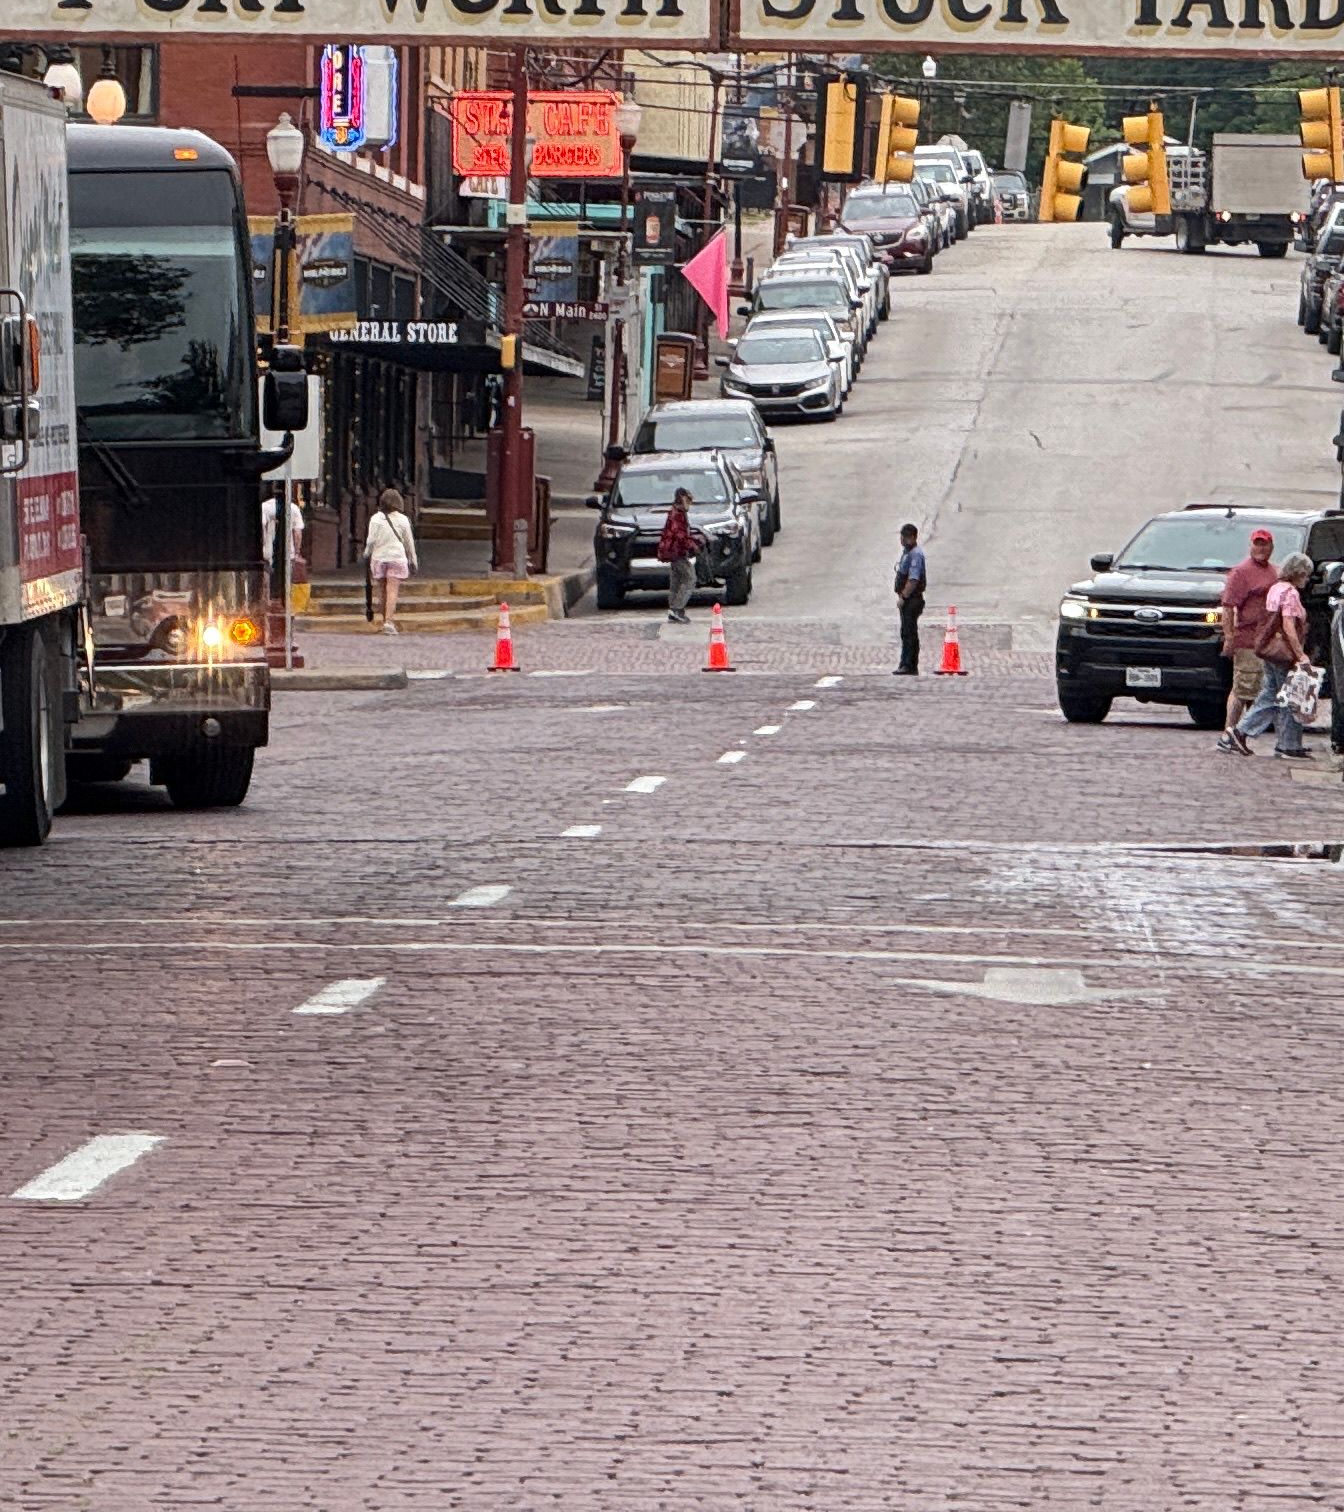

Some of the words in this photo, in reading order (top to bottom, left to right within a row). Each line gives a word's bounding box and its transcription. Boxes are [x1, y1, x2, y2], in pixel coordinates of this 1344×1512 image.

[465, 102, 532, 136] STA
[544, 102, 610, 136] CAFE
[473, 145, 511, 167] STEA
[533, 145, 602, 167] BURGERS
[540, 302, 549, 316] N
[555, 303, 586, 318] Main
[407, 322, 458, 343] STORE
